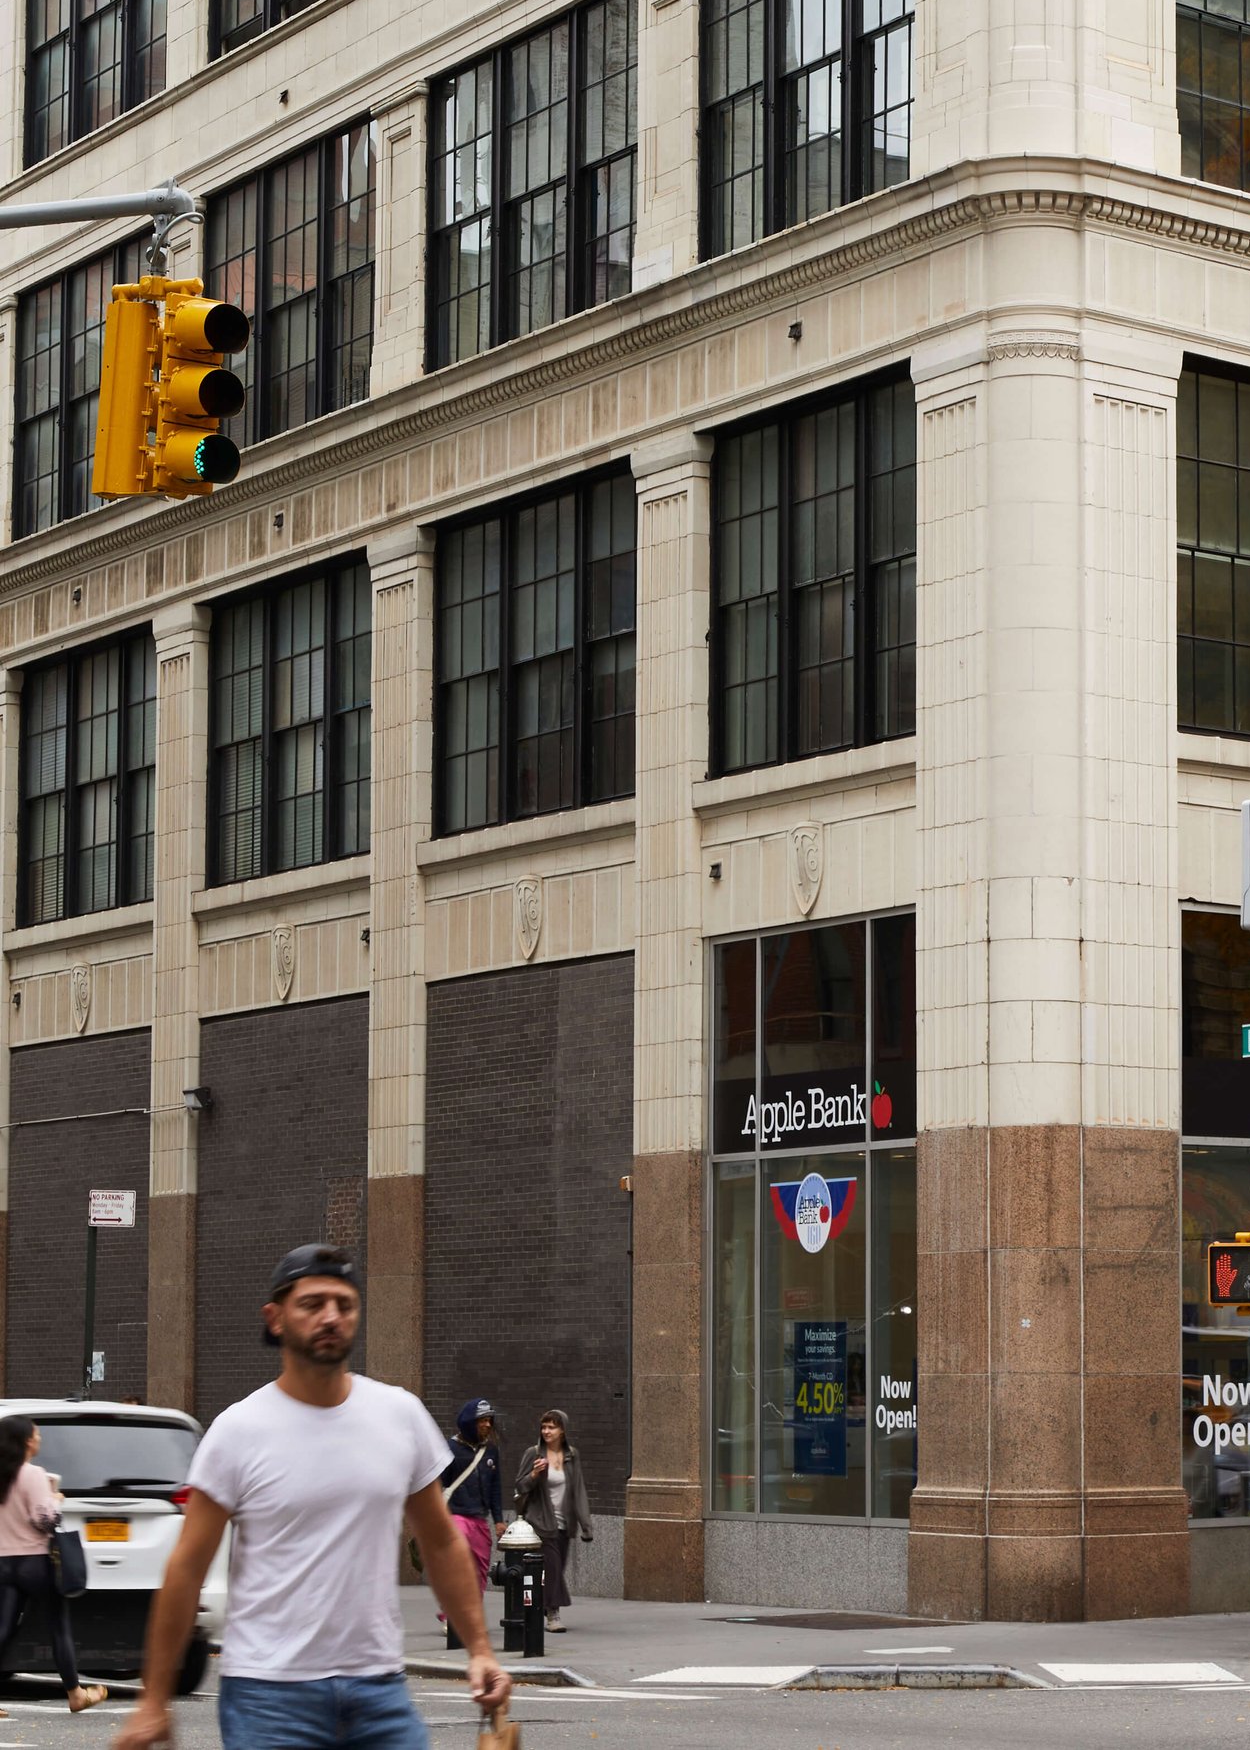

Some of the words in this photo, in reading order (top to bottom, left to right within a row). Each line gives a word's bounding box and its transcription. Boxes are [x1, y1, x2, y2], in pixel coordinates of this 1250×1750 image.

[741, 1091, 806, 1143] Apple
[808, 1084, 866, 1129] Bank
[798, 1195, 820, 1212] Apple
[798, 1211, 818, 1225] Bank
[805, 1328, 837, 1342] Maximize
[805, 1346, 816, 1355] your
[817, 1344, 836, 1355] savings.
[826, 1372, 833, 1381] CD
[881, 1375, 911, 1399] Now
[796, 1382, 844, 1414] 4.50%
[875, 1404, 917, 1434] Open!
